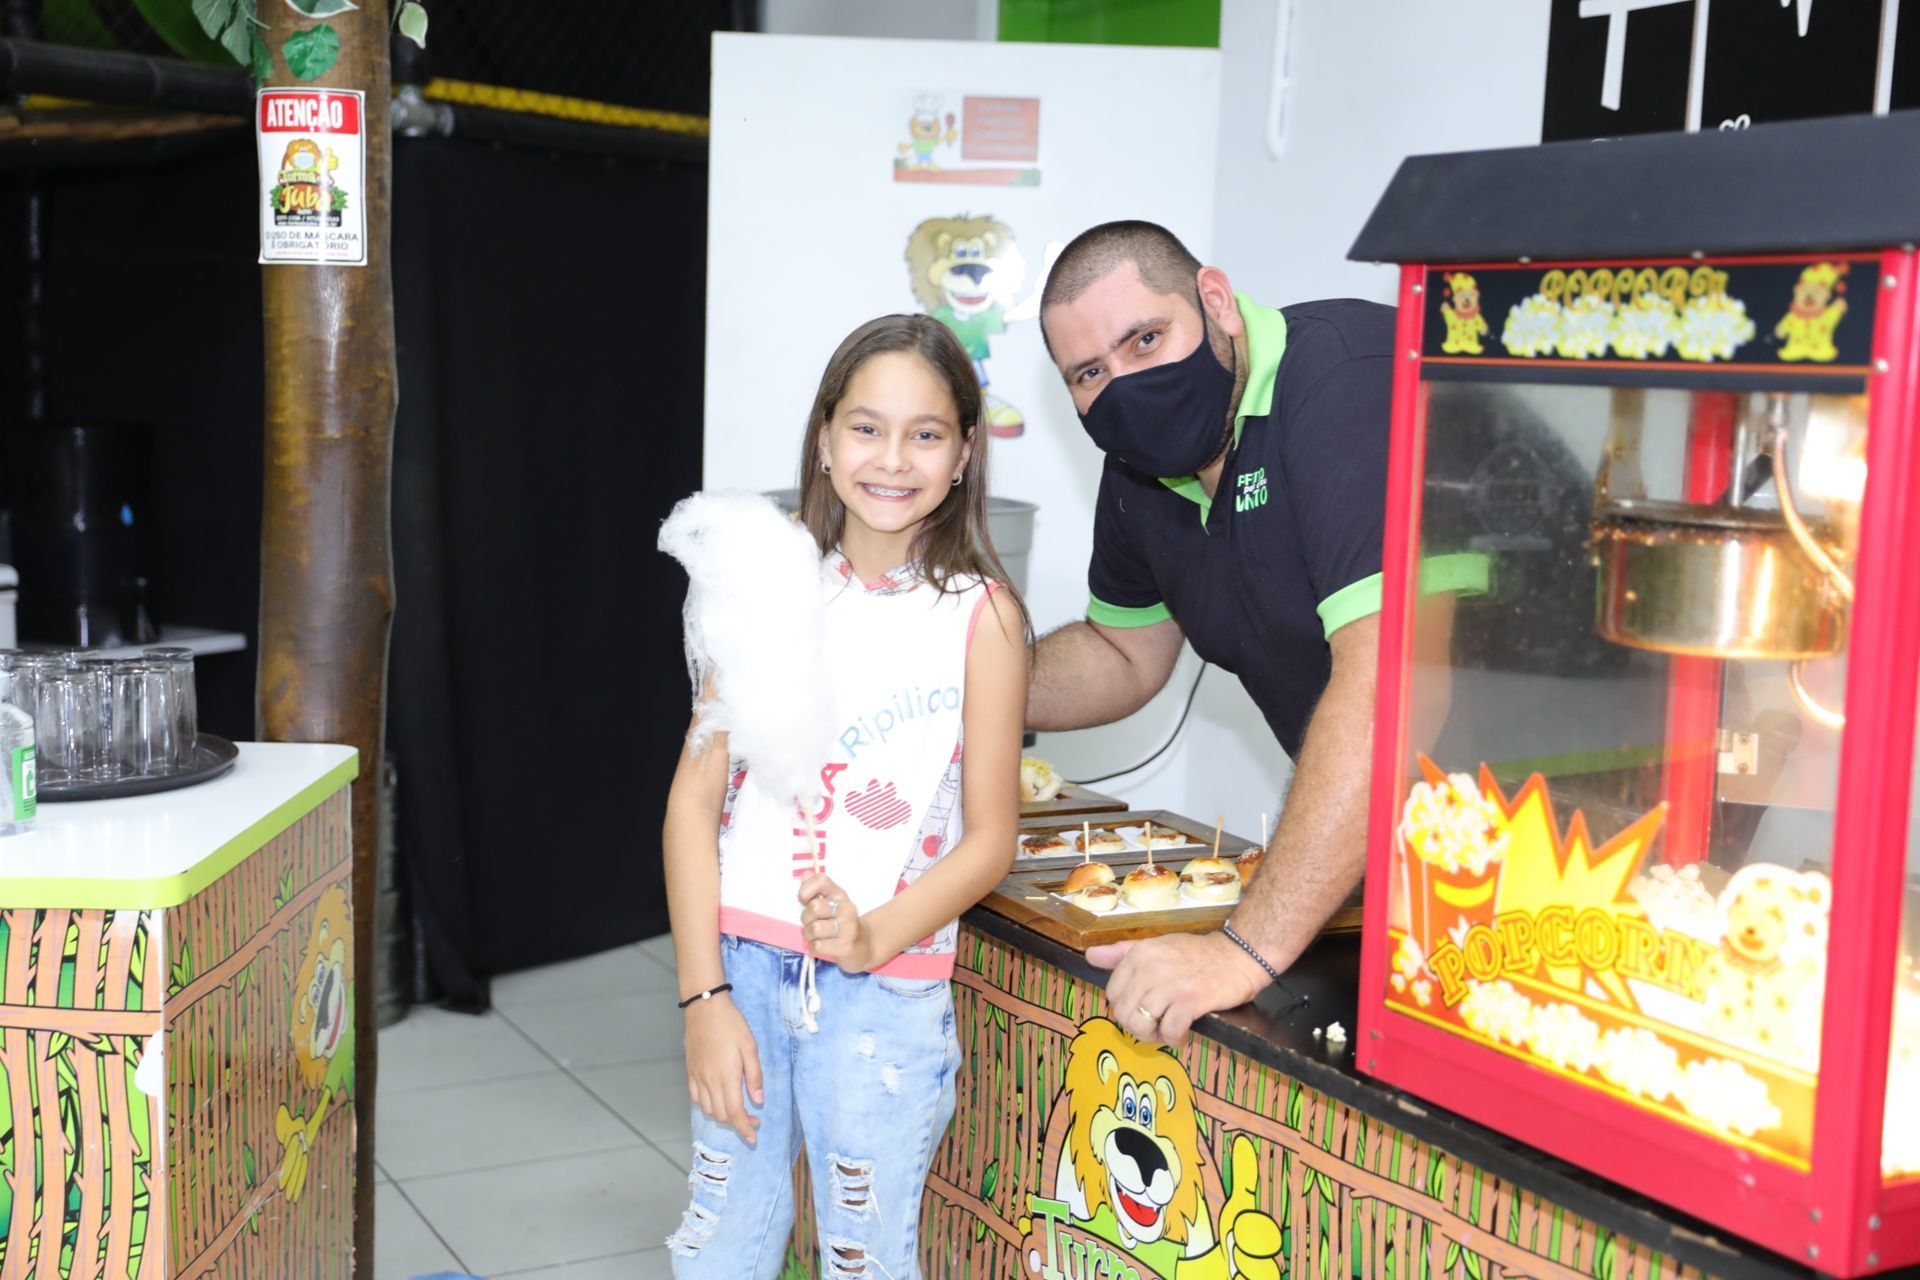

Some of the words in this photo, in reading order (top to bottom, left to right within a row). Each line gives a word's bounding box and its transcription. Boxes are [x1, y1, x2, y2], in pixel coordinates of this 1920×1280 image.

[266, 95, 343, 132] ATENÇÃO
[839, 685, 961, 760] Ripilica
[1429, 905, 1719, 1008] POPCORN
